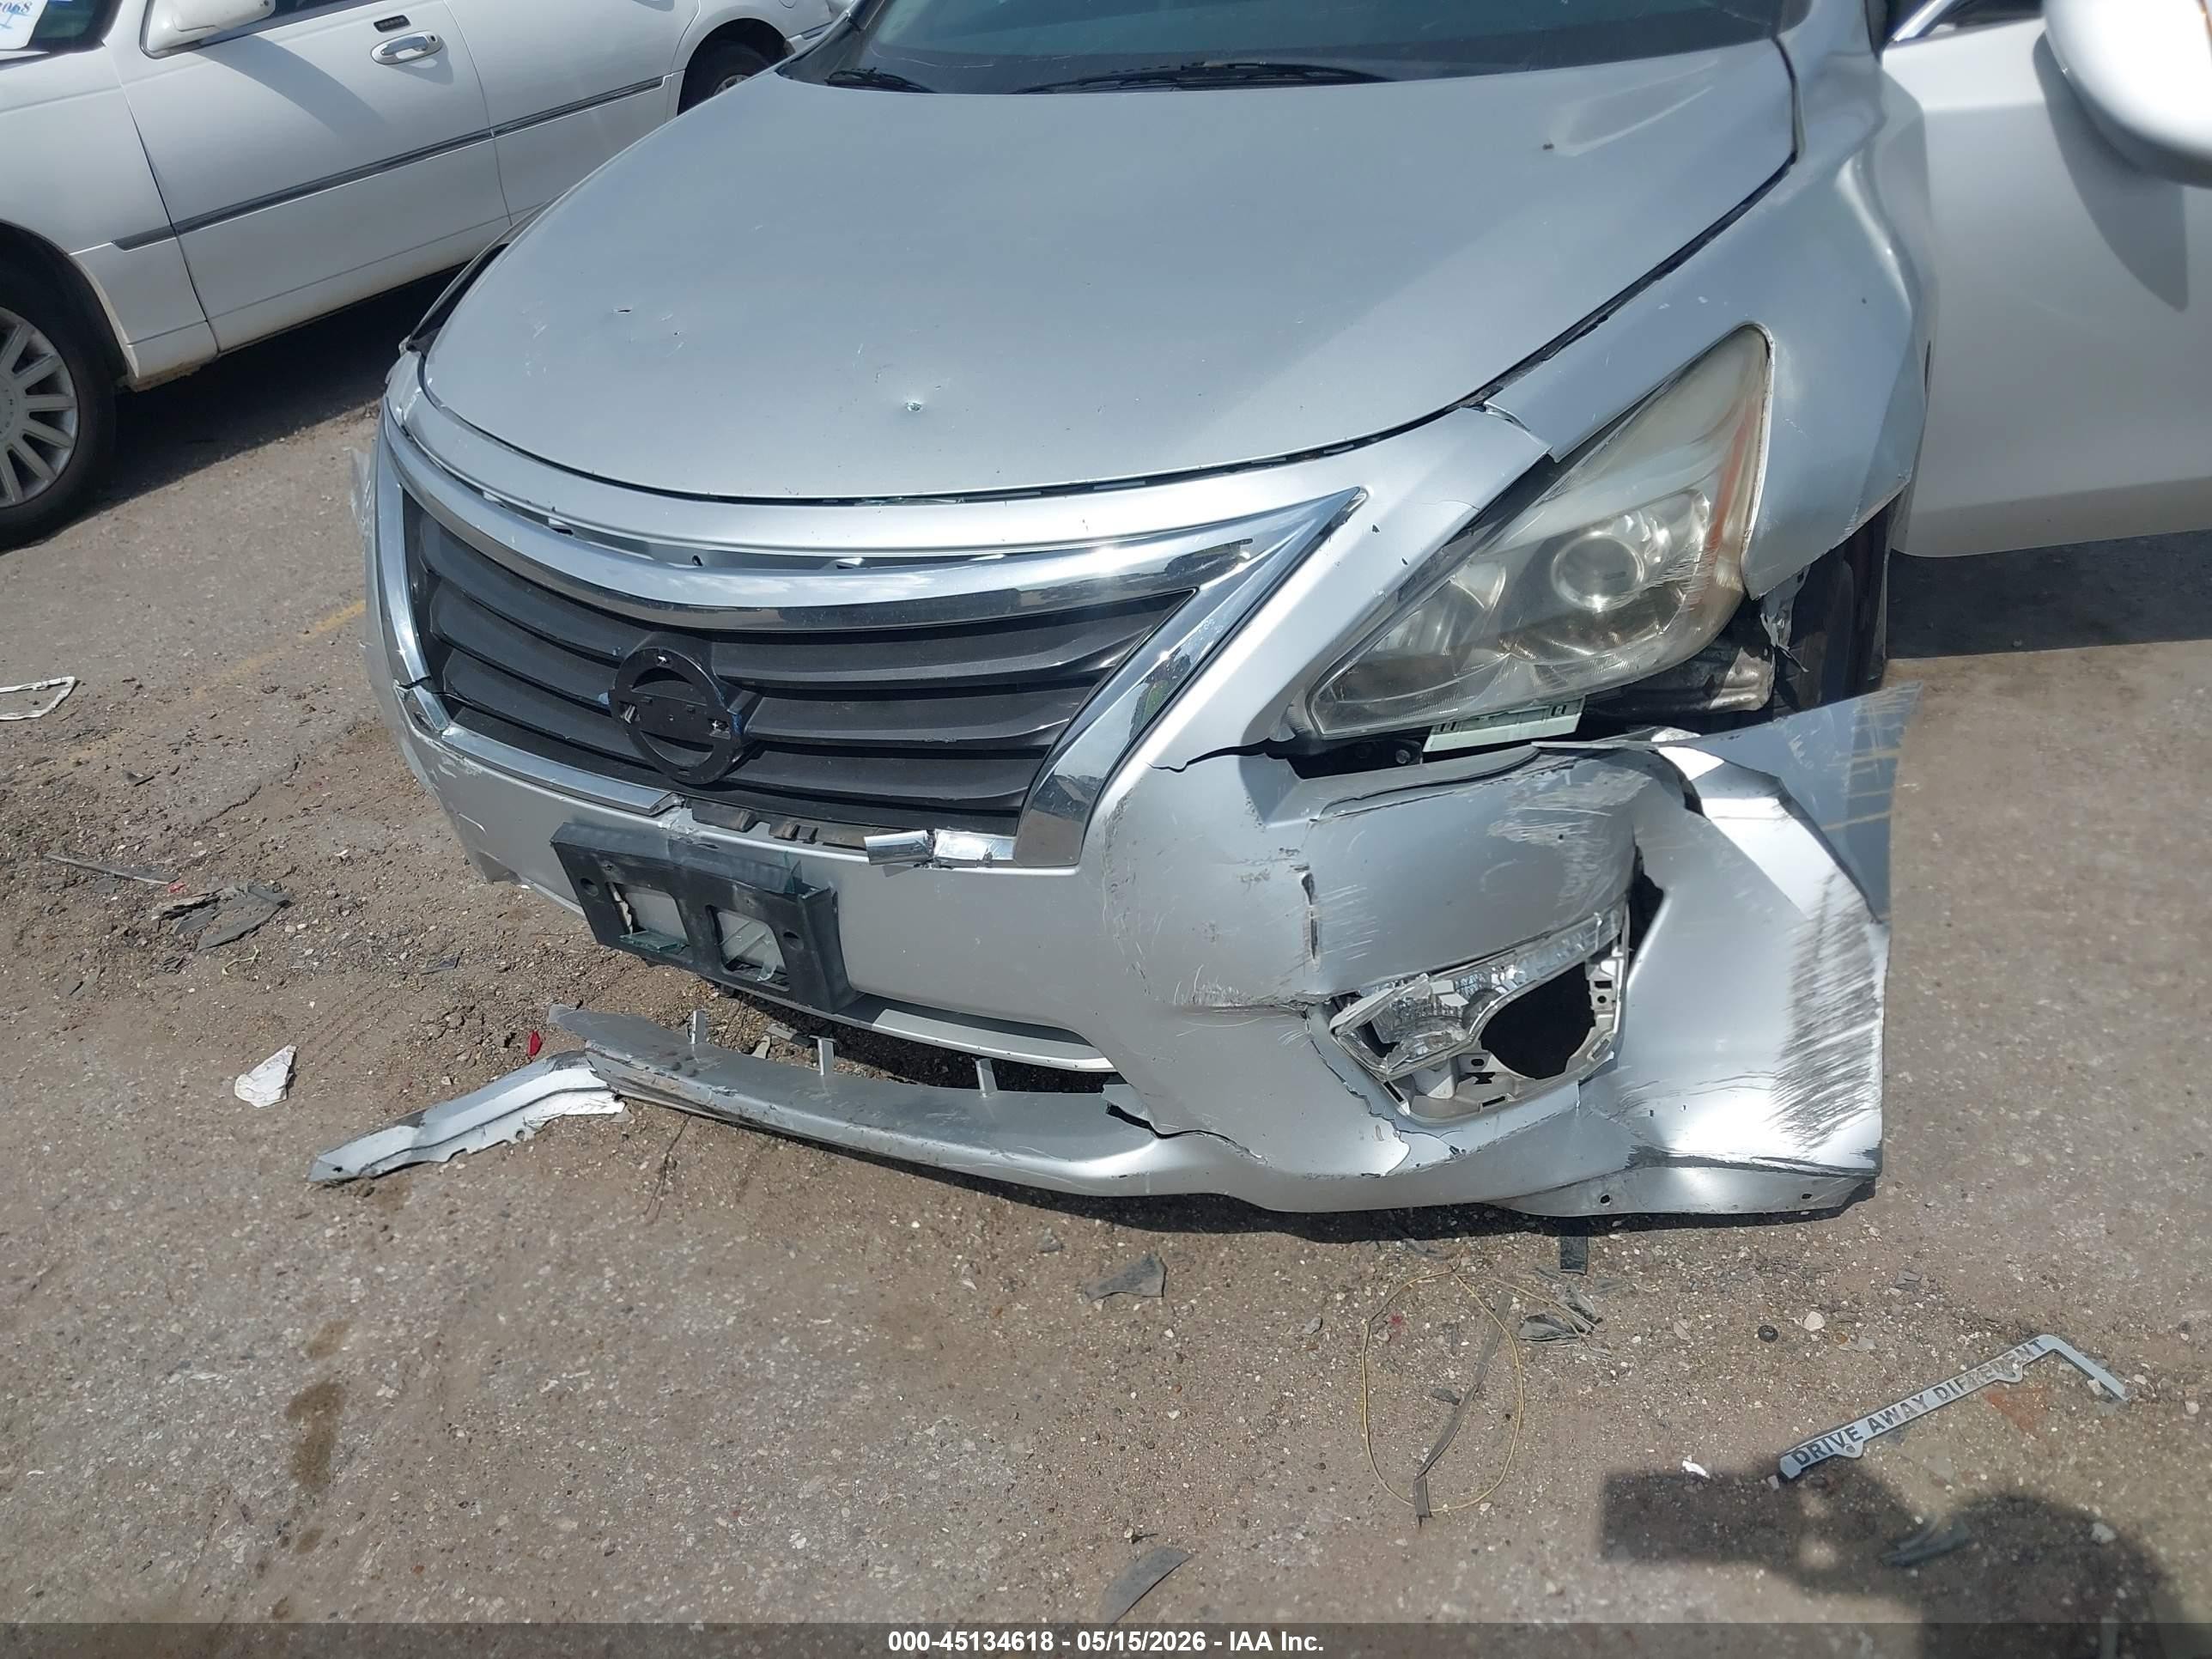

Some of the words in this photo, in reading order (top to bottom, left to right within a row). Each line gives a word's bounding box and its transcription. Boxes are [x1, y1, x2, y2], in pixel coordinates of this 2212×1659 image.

[0, 1, 33, 15] 068
[1790, 1425, 1863, 1467] DRIVE
[1865, 1394, 1930, 1434] AWAY
